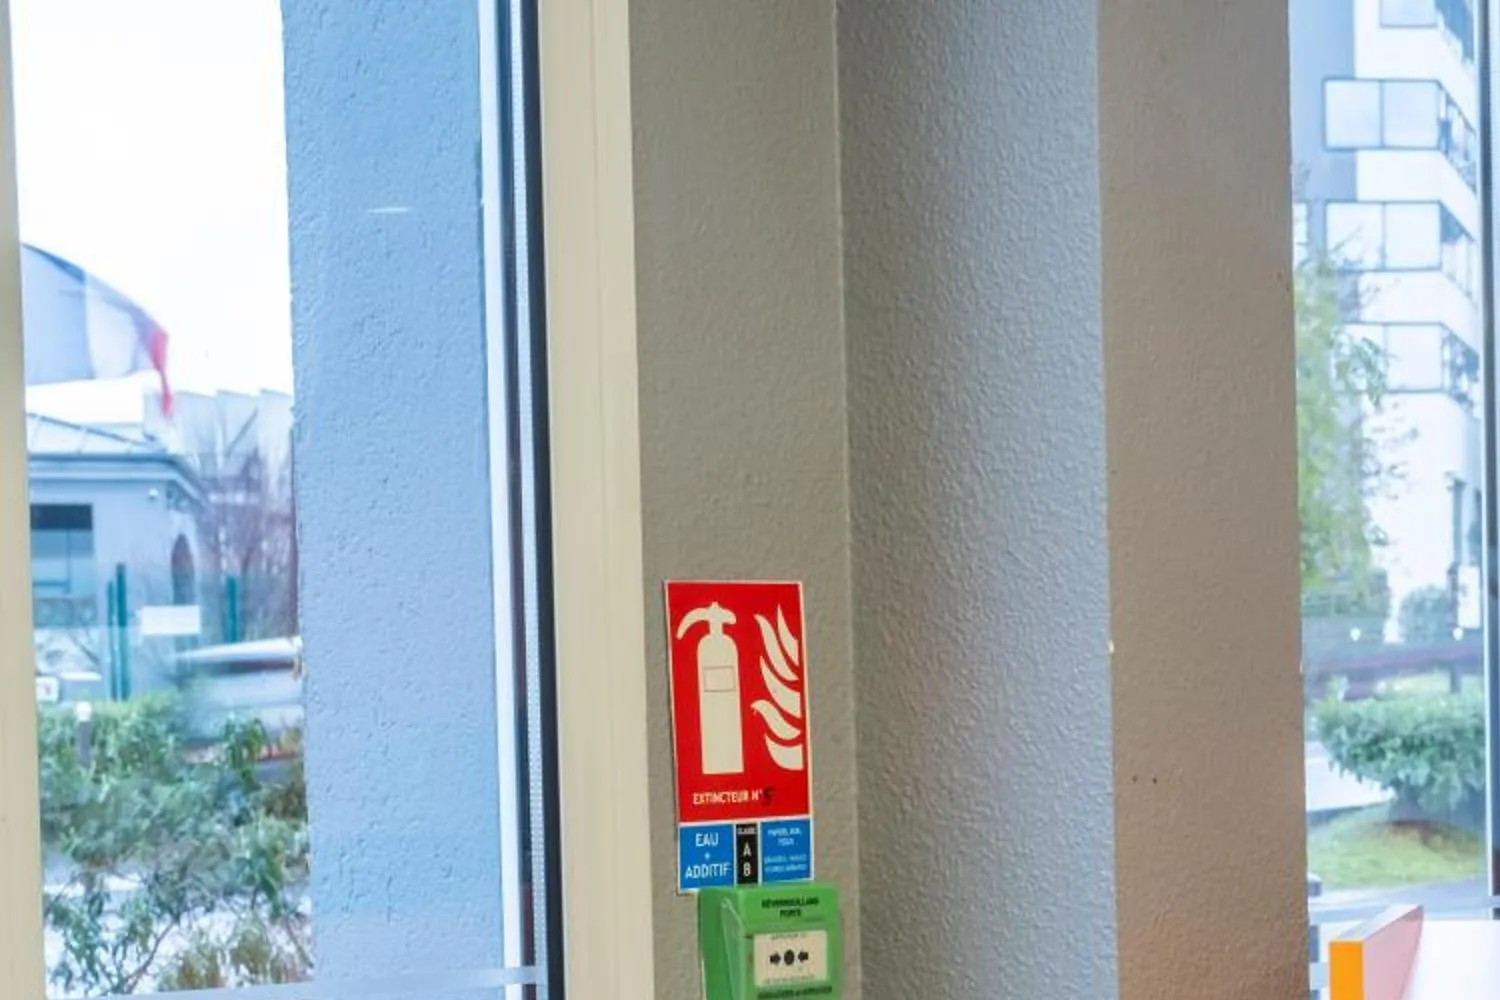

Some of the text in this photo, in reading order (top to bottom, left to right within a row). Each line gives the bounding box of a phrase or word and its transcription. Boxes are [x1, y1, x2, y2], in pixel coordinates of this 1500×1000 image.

[692, 790, 750, 805] EXTINCTEUR
[695, 832, 719, 847] EAU
[743, 842, 752, 857] A
[685, 863, 731, 879] ADDITIF
